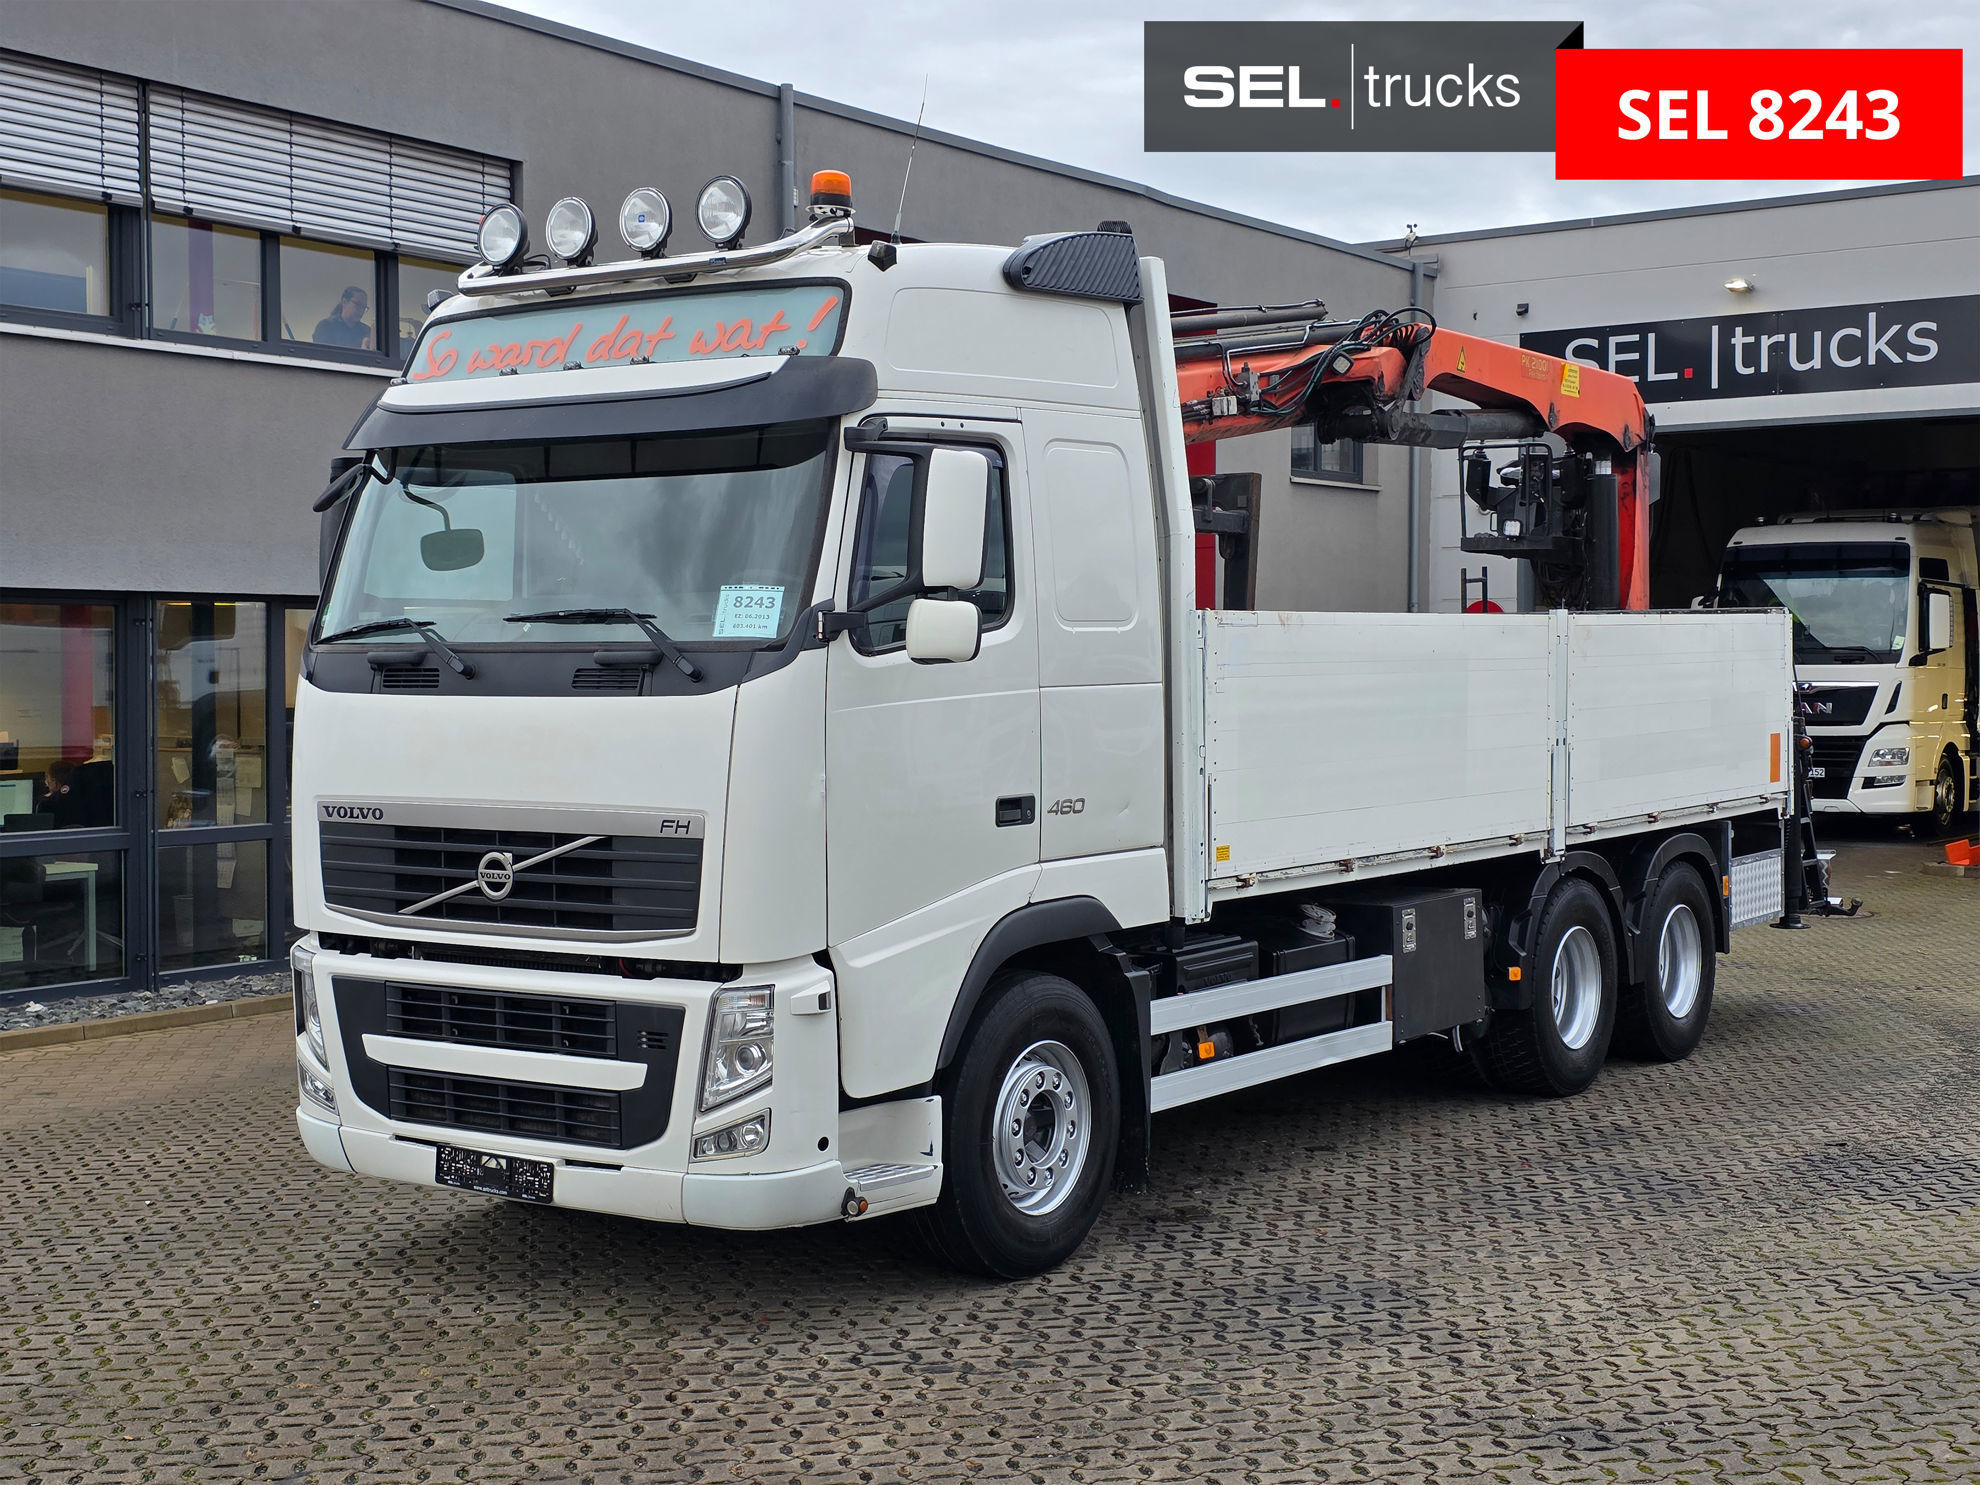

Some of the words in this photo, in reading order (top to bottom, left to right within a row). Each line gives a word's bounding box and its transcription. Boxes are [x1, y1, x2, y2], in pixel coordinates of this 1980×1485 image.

[412, 330, 457, 381] So
[466, 323, 583, 374] ward
[585, 314, 675, 364] dat
[1730, 311, 1939, 376] trucks
[733, 596, 776, 609] 8243
[1793, 702, 1833, 714] AN
[322, 805, 384, 821] VOLVO
[1047, 798, 1086, 816] 460
[659, 819, 691, 835] FH
[480, 871, 511, 880] VOLVO
